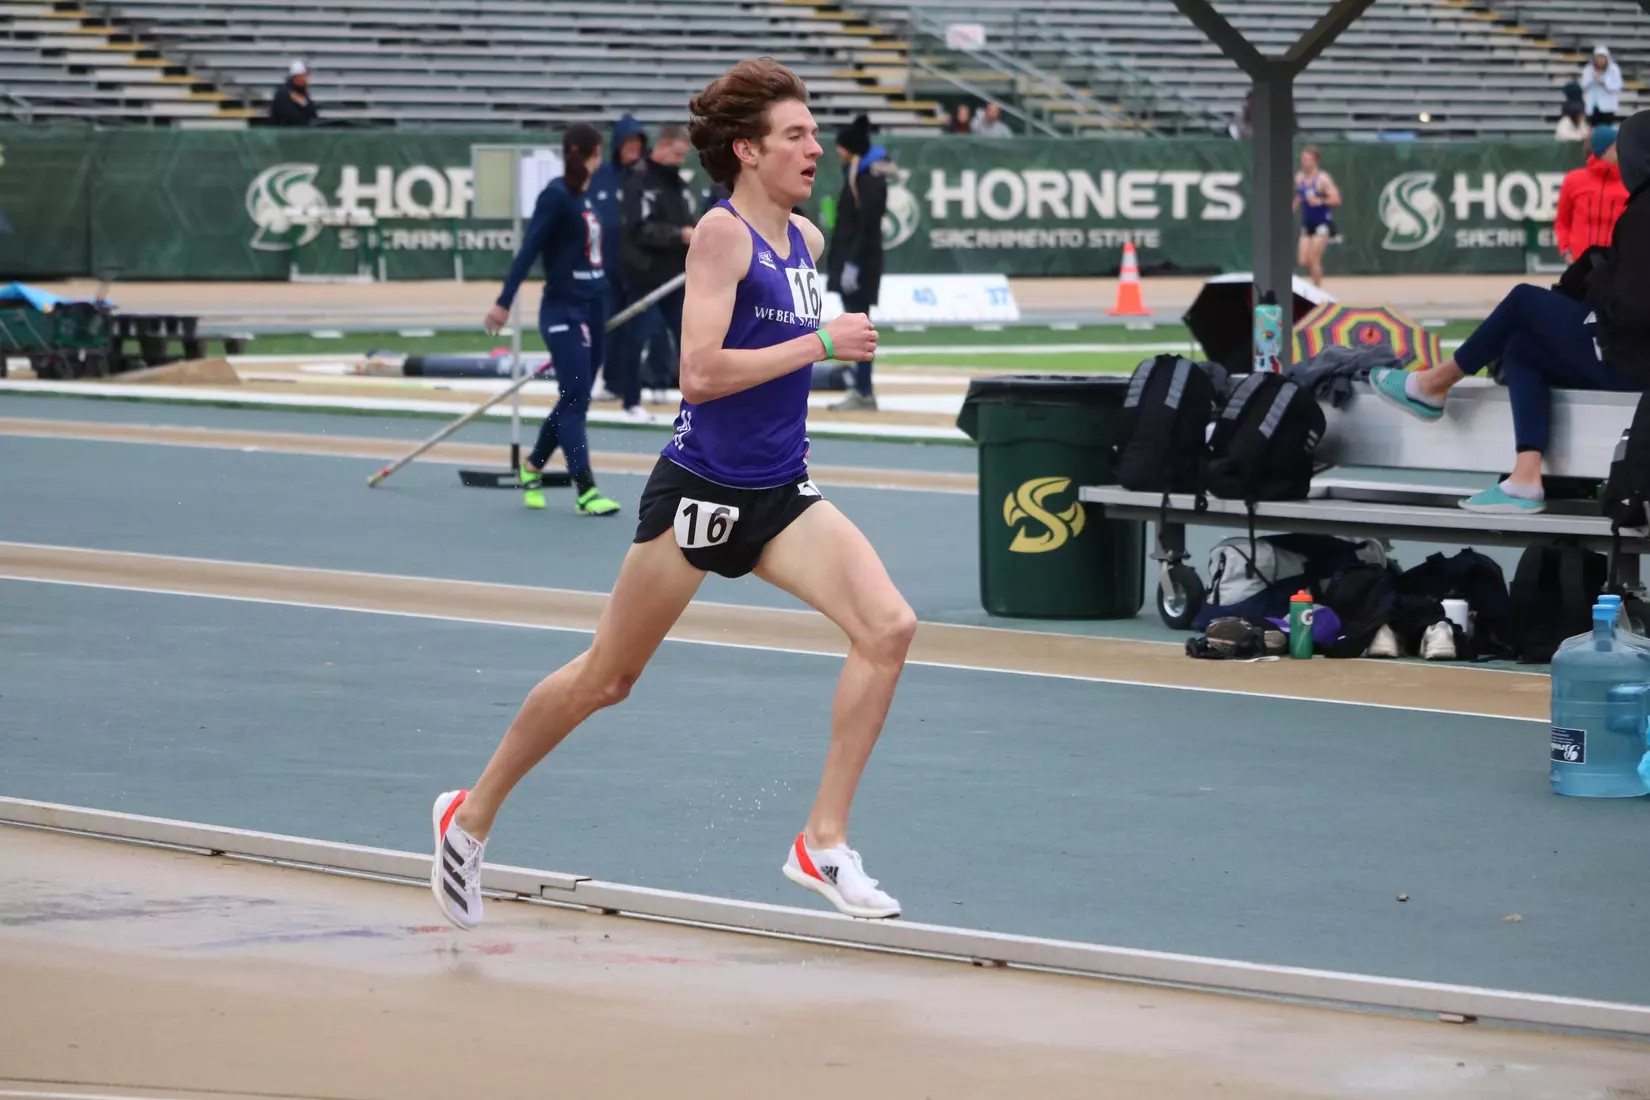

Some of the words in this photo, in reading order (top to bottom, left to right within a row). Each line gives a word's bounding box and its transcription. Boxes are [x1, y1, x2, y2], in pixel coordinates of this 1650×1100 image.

[926, 169, 1245, 220] HORNETS
[929, 228, 1084, 248] SACRAMENTO
[1088, 228, 1160, 248] STATE
[754, 305, 796, 325] WEBER
[794, 271, 819, 317] 16
[683, 503, 731, 546] 16
